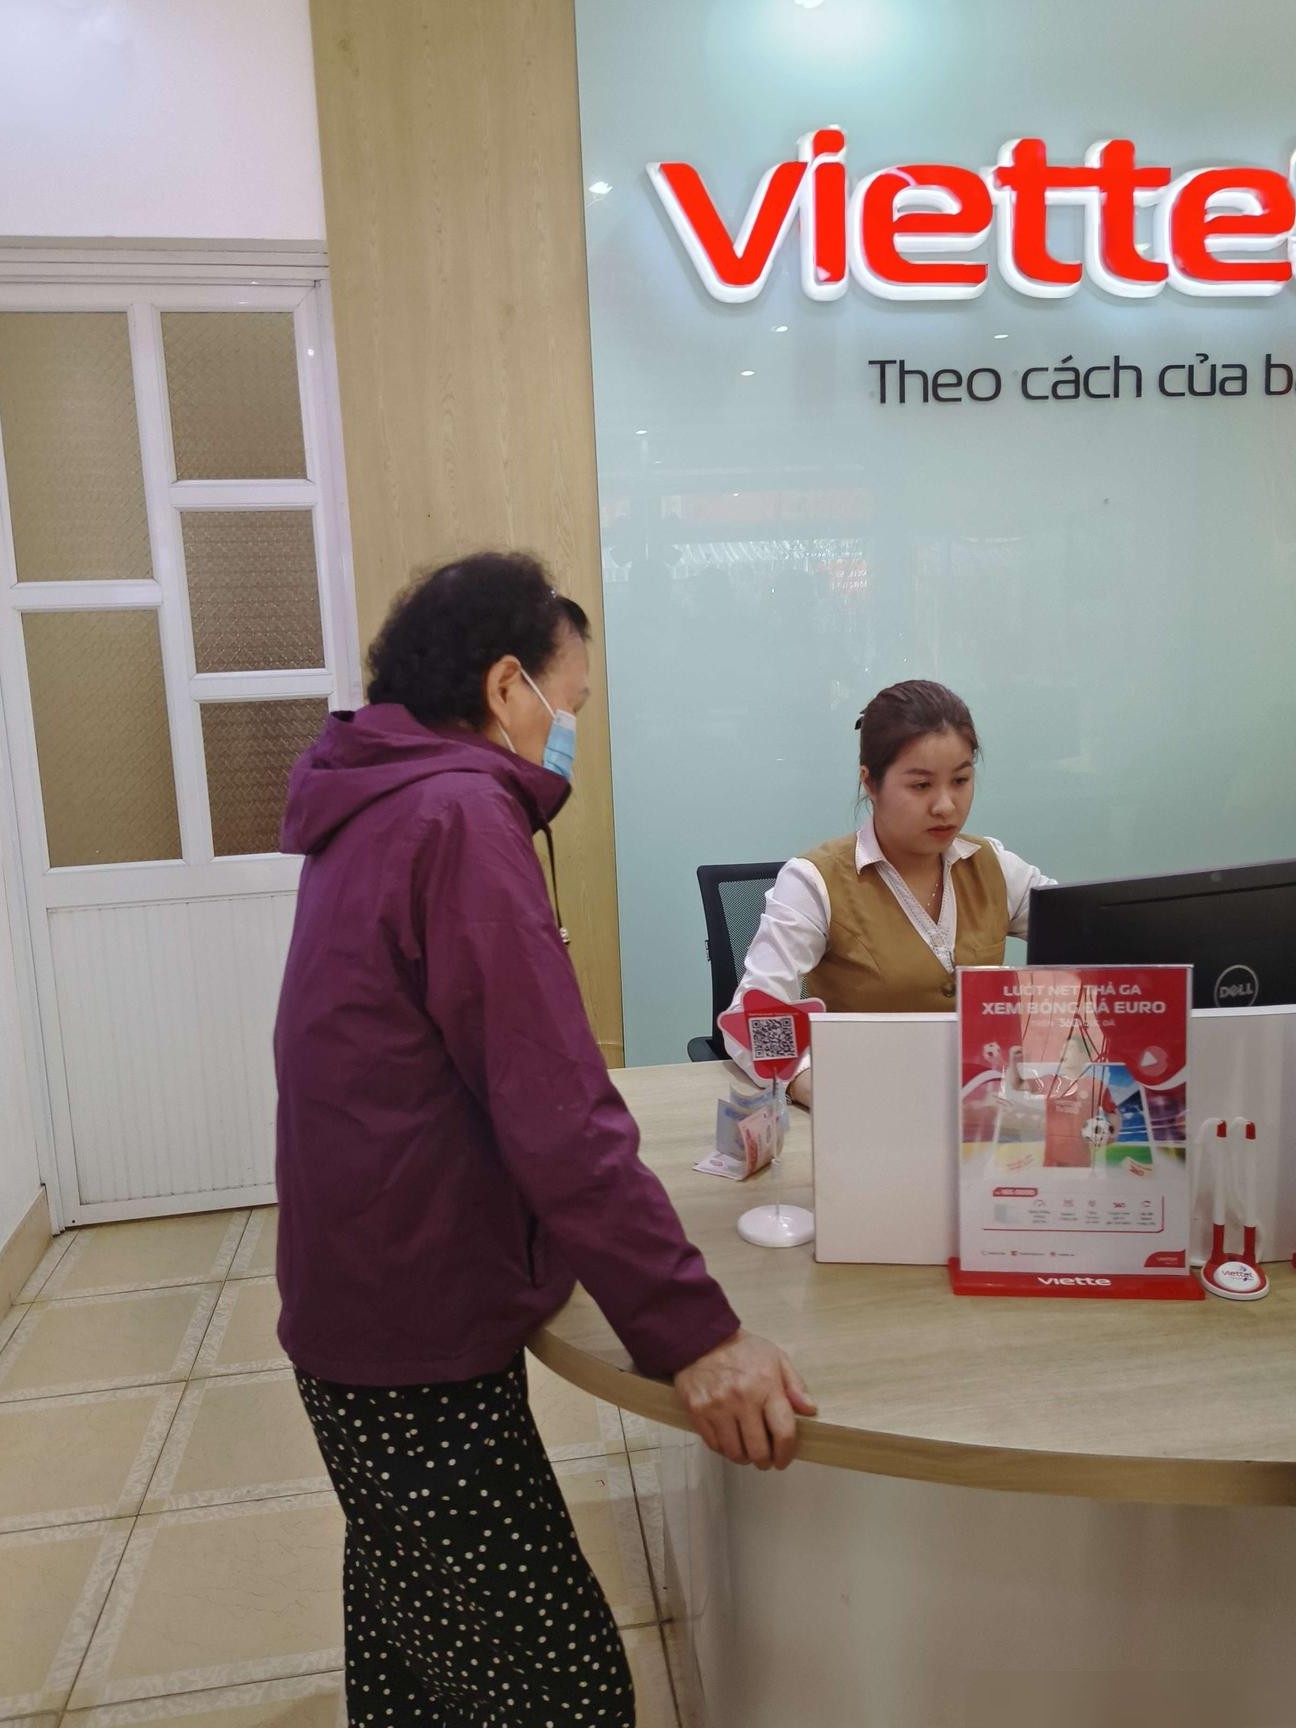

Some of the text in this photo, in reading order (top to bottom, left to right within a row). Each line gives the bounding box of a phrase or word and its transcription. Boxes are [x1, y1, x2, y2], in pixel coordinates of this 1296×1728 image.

[647, 125, 1296, 302] viette
[868, 353, 1296, 404] Theo cách của b
[1048, 984, 1081, 996] NET
[1119, 983, 1142, 996] GA
[1219, 982, 1253, 999] DELL
[982, 1002, 1023, 1016] XEM
[1114, 1000, 1167, 1015] EURO
